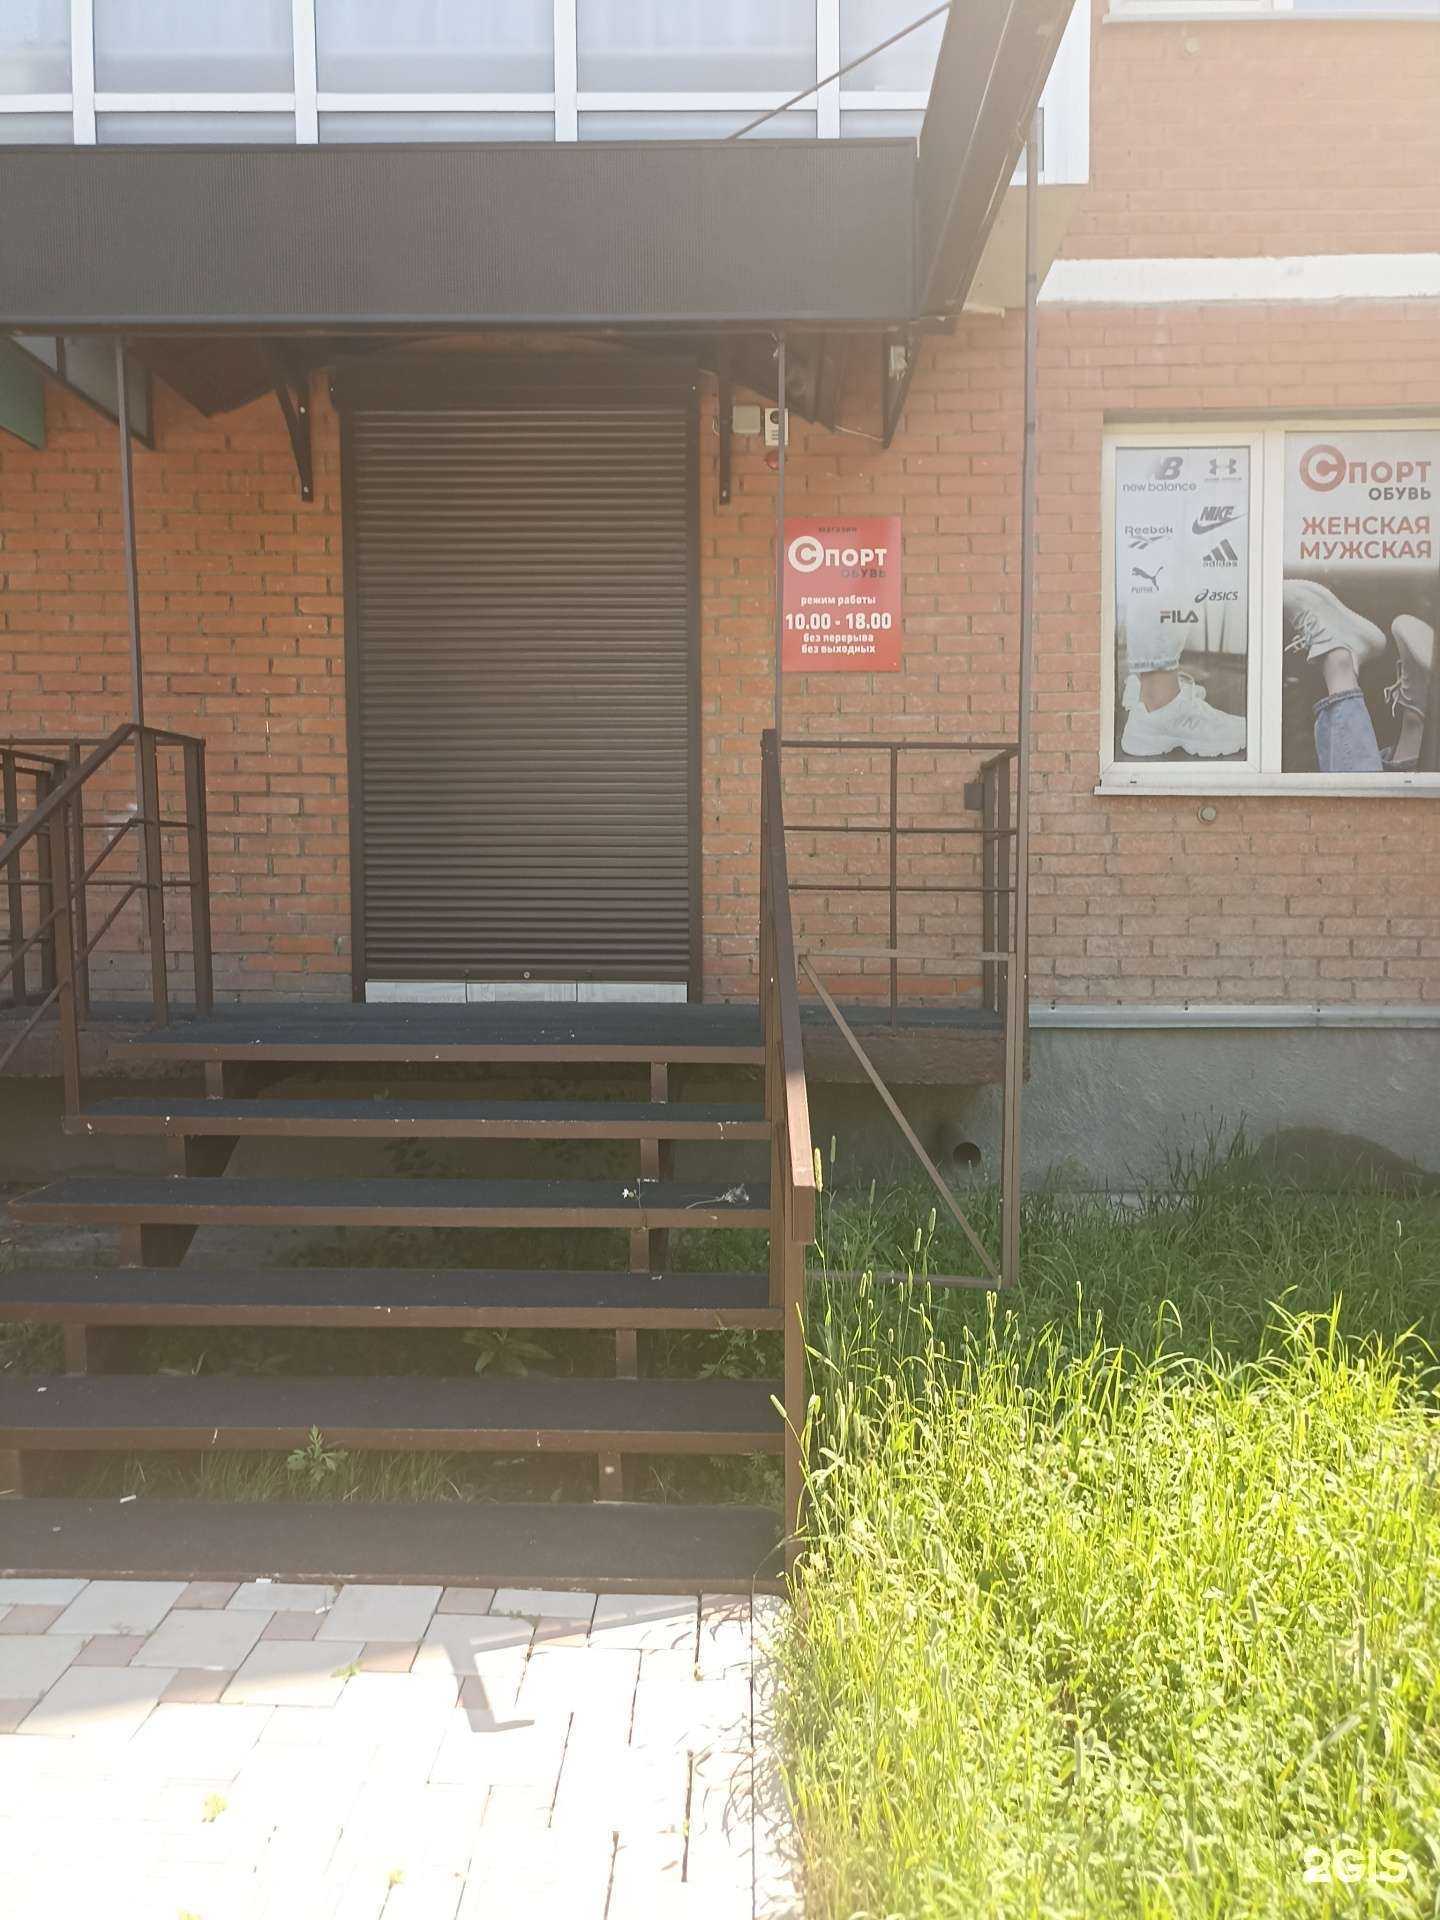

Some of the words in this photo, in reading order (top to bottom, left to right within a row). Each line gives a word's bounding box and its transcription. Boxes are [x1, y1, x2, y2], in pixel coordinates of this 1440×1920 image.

[1122, 482, 1146, 492] new
[1148, 482, 1197, 492] balance
[1368, 487, 1432, 501] ОБУВЬ
[1200, 506, 1234, 521] NIKE
[1124, 525, 1174, 536] Reebok
[1302, 516, 1431, 535] ЖЕНСКАЯ
[1300, 540, 1432, 560] МУЖСКАЯ
[1202, 560, 1238, 568] adidas
[800, 596, 836, 607] режим
[837, 594, 876, 607] работы
[785, 613, 831, 630] 10.00
[846, 612, 892, 630] 18.00
[1160, 610, 1199, 624] FILA
[803, 633, 821, 642] без
[823, 634, 874, 645] перерыва
[801, 644, 819, 654] без
[821, 645, 876, 656] выходных
